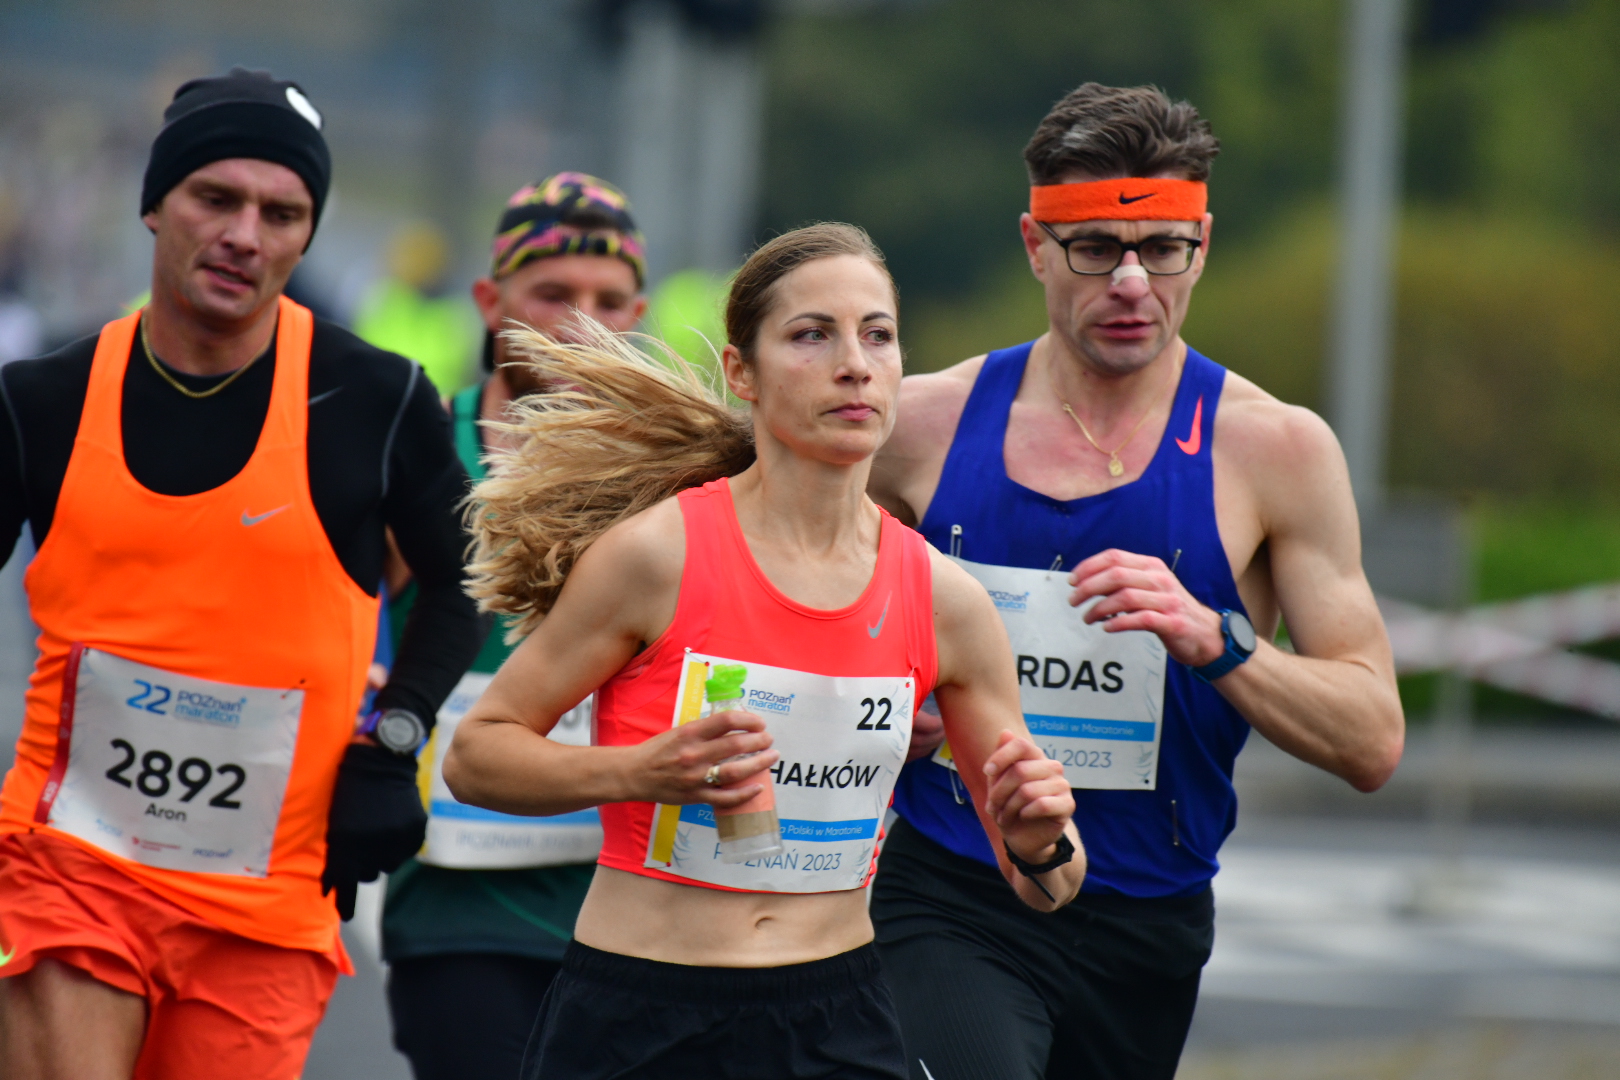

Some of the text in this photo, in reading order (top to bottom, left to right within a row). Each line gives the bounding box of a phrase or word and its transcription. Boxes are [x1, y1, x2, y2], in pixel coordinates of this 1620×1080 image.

[126, 679, 172, 716] 22
[747, 698, 791, 712] maraton
[175, 704, 241, 725] maraton
[856, 697, 893, 731] 22
[1062, 749, 1112, 768] 2023
[105, 738, 247, 810] 2892
[145, 803, 187, 822] Aron
[787, 824, 815, 836] Polski
[825, 825, 864, 836] Maratonie
[802, 852, 842, 872] 2023
